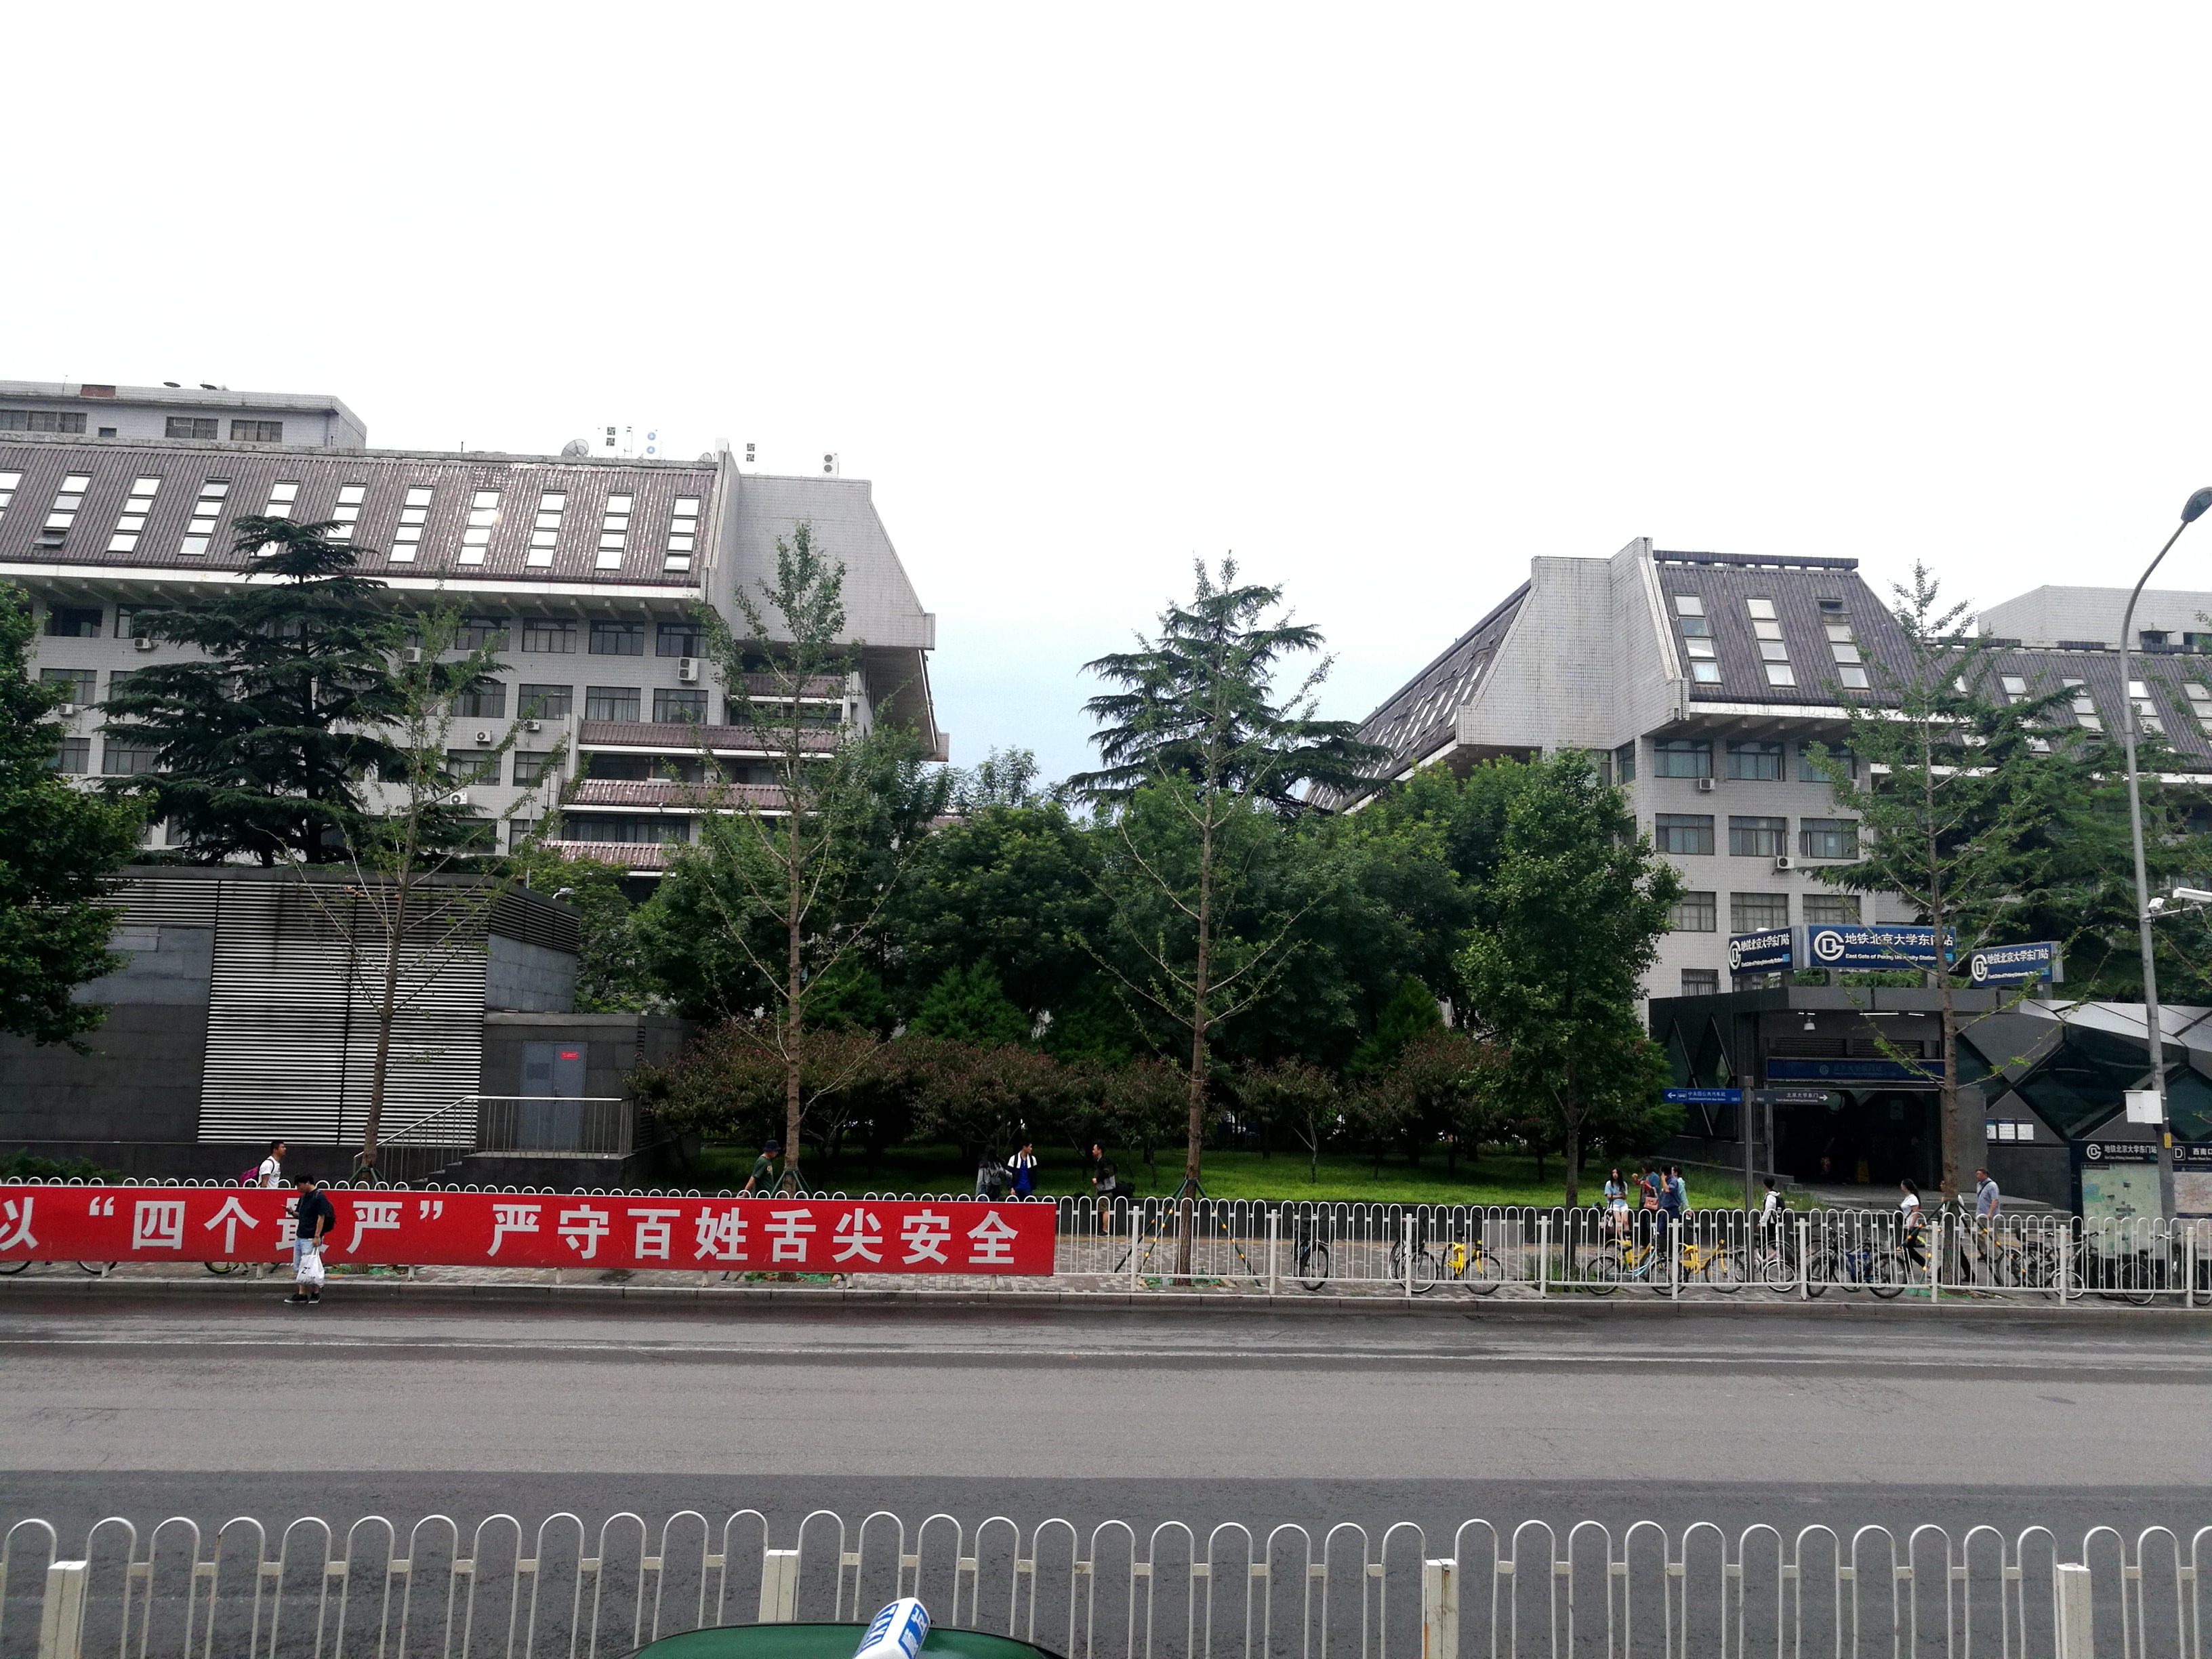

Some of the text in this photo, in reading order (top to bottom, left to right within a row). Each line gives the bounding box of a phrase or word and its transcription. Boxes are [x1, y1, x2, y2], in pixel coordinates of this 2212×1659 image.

[1740, 933, 1790, 951] 地铁北京大学东门站
[1986, 948, 2049, 964] 地铁北京大学东门站
[2104, 1145, 2157, 1154] 地铁北京大学东门站
[2174, 1148, 2183, 1158] D
[861, 1605, 897, 1650] TAXI
